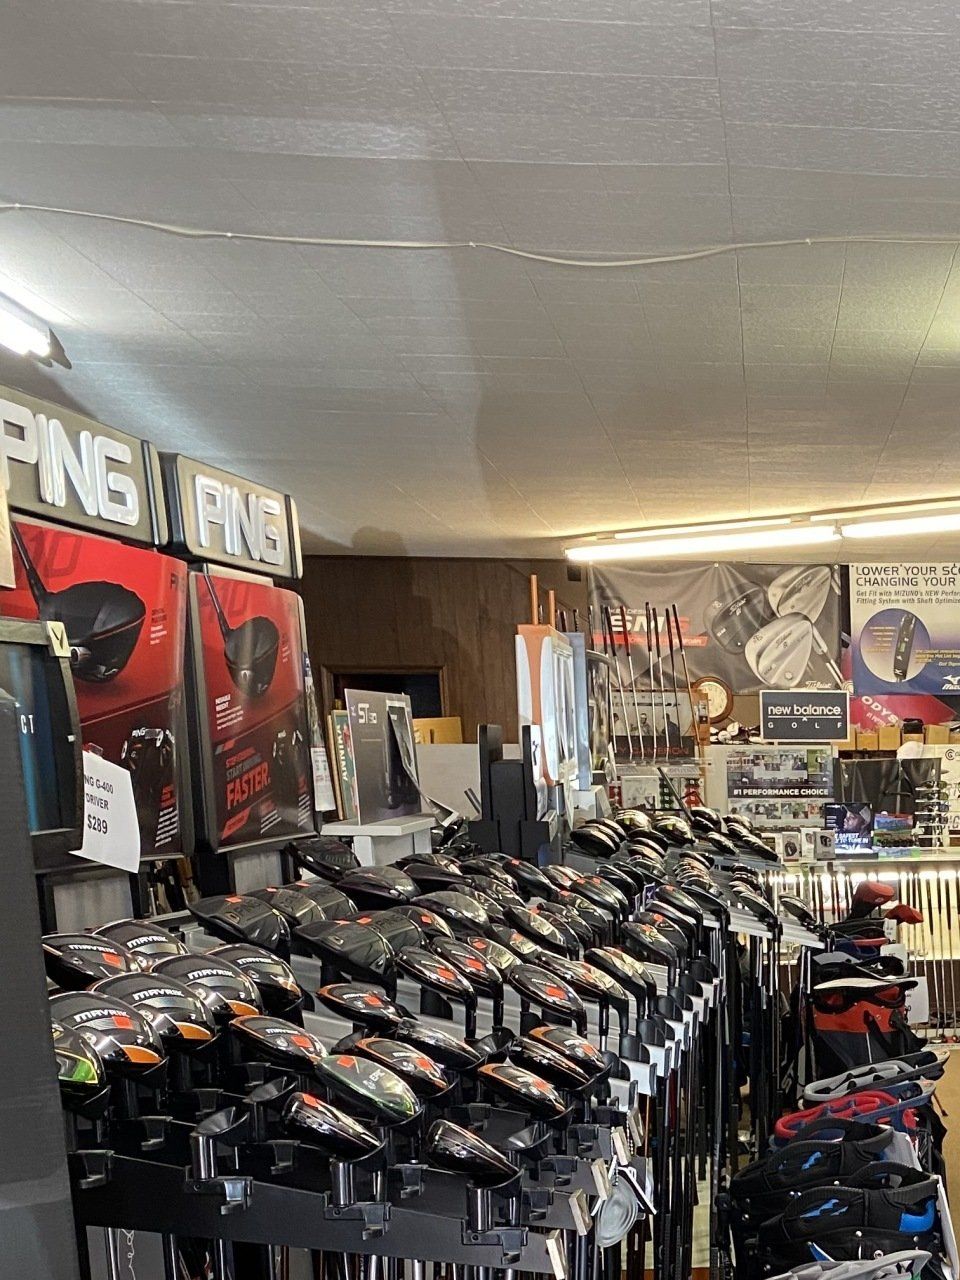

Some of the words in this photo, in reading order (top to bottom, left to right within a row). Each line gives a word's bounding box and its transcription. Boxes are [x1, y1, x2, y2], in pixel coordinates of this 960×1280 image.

[0, 400, 140, 526] PING
[194, 473, 285, 566] PING
[856, 565, 899, 576] LOWER
[904, 565, 937, 576] YOUR
[856, 577, 918, 587] CHANGING
[924, 577, 956, 587] YOUR
[768, 706, 790, 715] new
[793, 704, 841, 715] balance
[95, 779, 114, 795] G-400
[226, 761, 272, 810] FASTER.
[733, 788, 742, 796] #1
[743, 788, 799, 796] PERFORMANCE
[801, 788, 829, 796] CHOICE
[86, 792, 109, 811] DRIVER
[87, 814, 108, 835] $289
[127, 935, 168, 949] MAVRIK
[237, 957, 276, 965] MAVRIK
[188, 969, 236, 980] MAVRIK
[133, 988, 184, 1001] MAVRIK
[74, 1009, 130, 1023] MAVRIK
